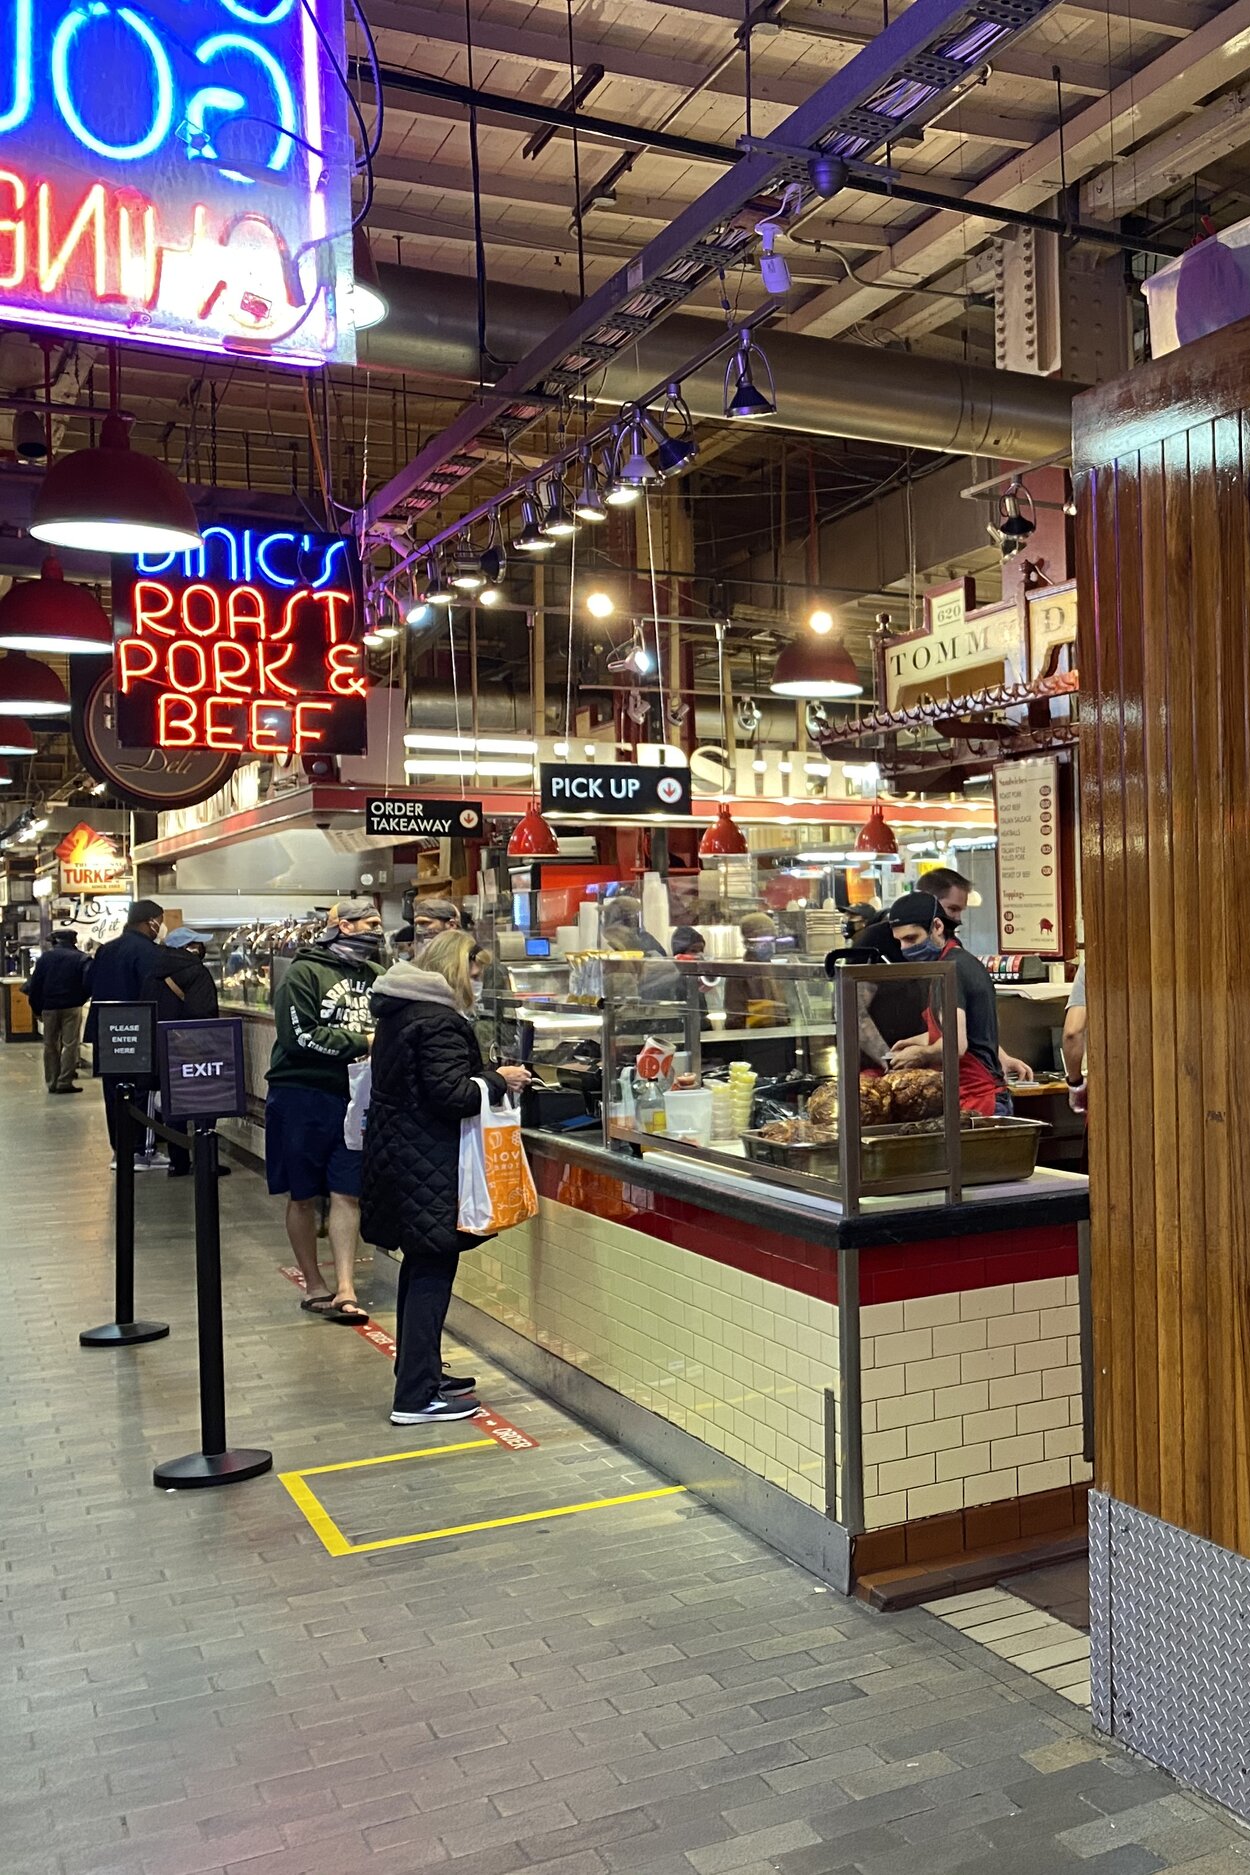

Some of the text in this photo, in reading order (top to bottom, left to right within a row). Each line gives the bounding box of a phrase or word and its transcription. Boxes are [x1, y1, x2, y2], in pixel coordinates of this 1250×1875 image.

[136, 582, 350, 642] ROAST
[937, 604, 961, 622] 620
[120, 640, 366, 697] PORK &
[160, 694, 332, 752] BEEF
[551, 777, 641, 799] PICK UP
[371, 801, 424, 816] ORDER
[370, 817, 452, 833] TAKEAWAY
[182, 1062, 224, 1078] EXIT
[491, 1427, 533, 1450] ORDER
